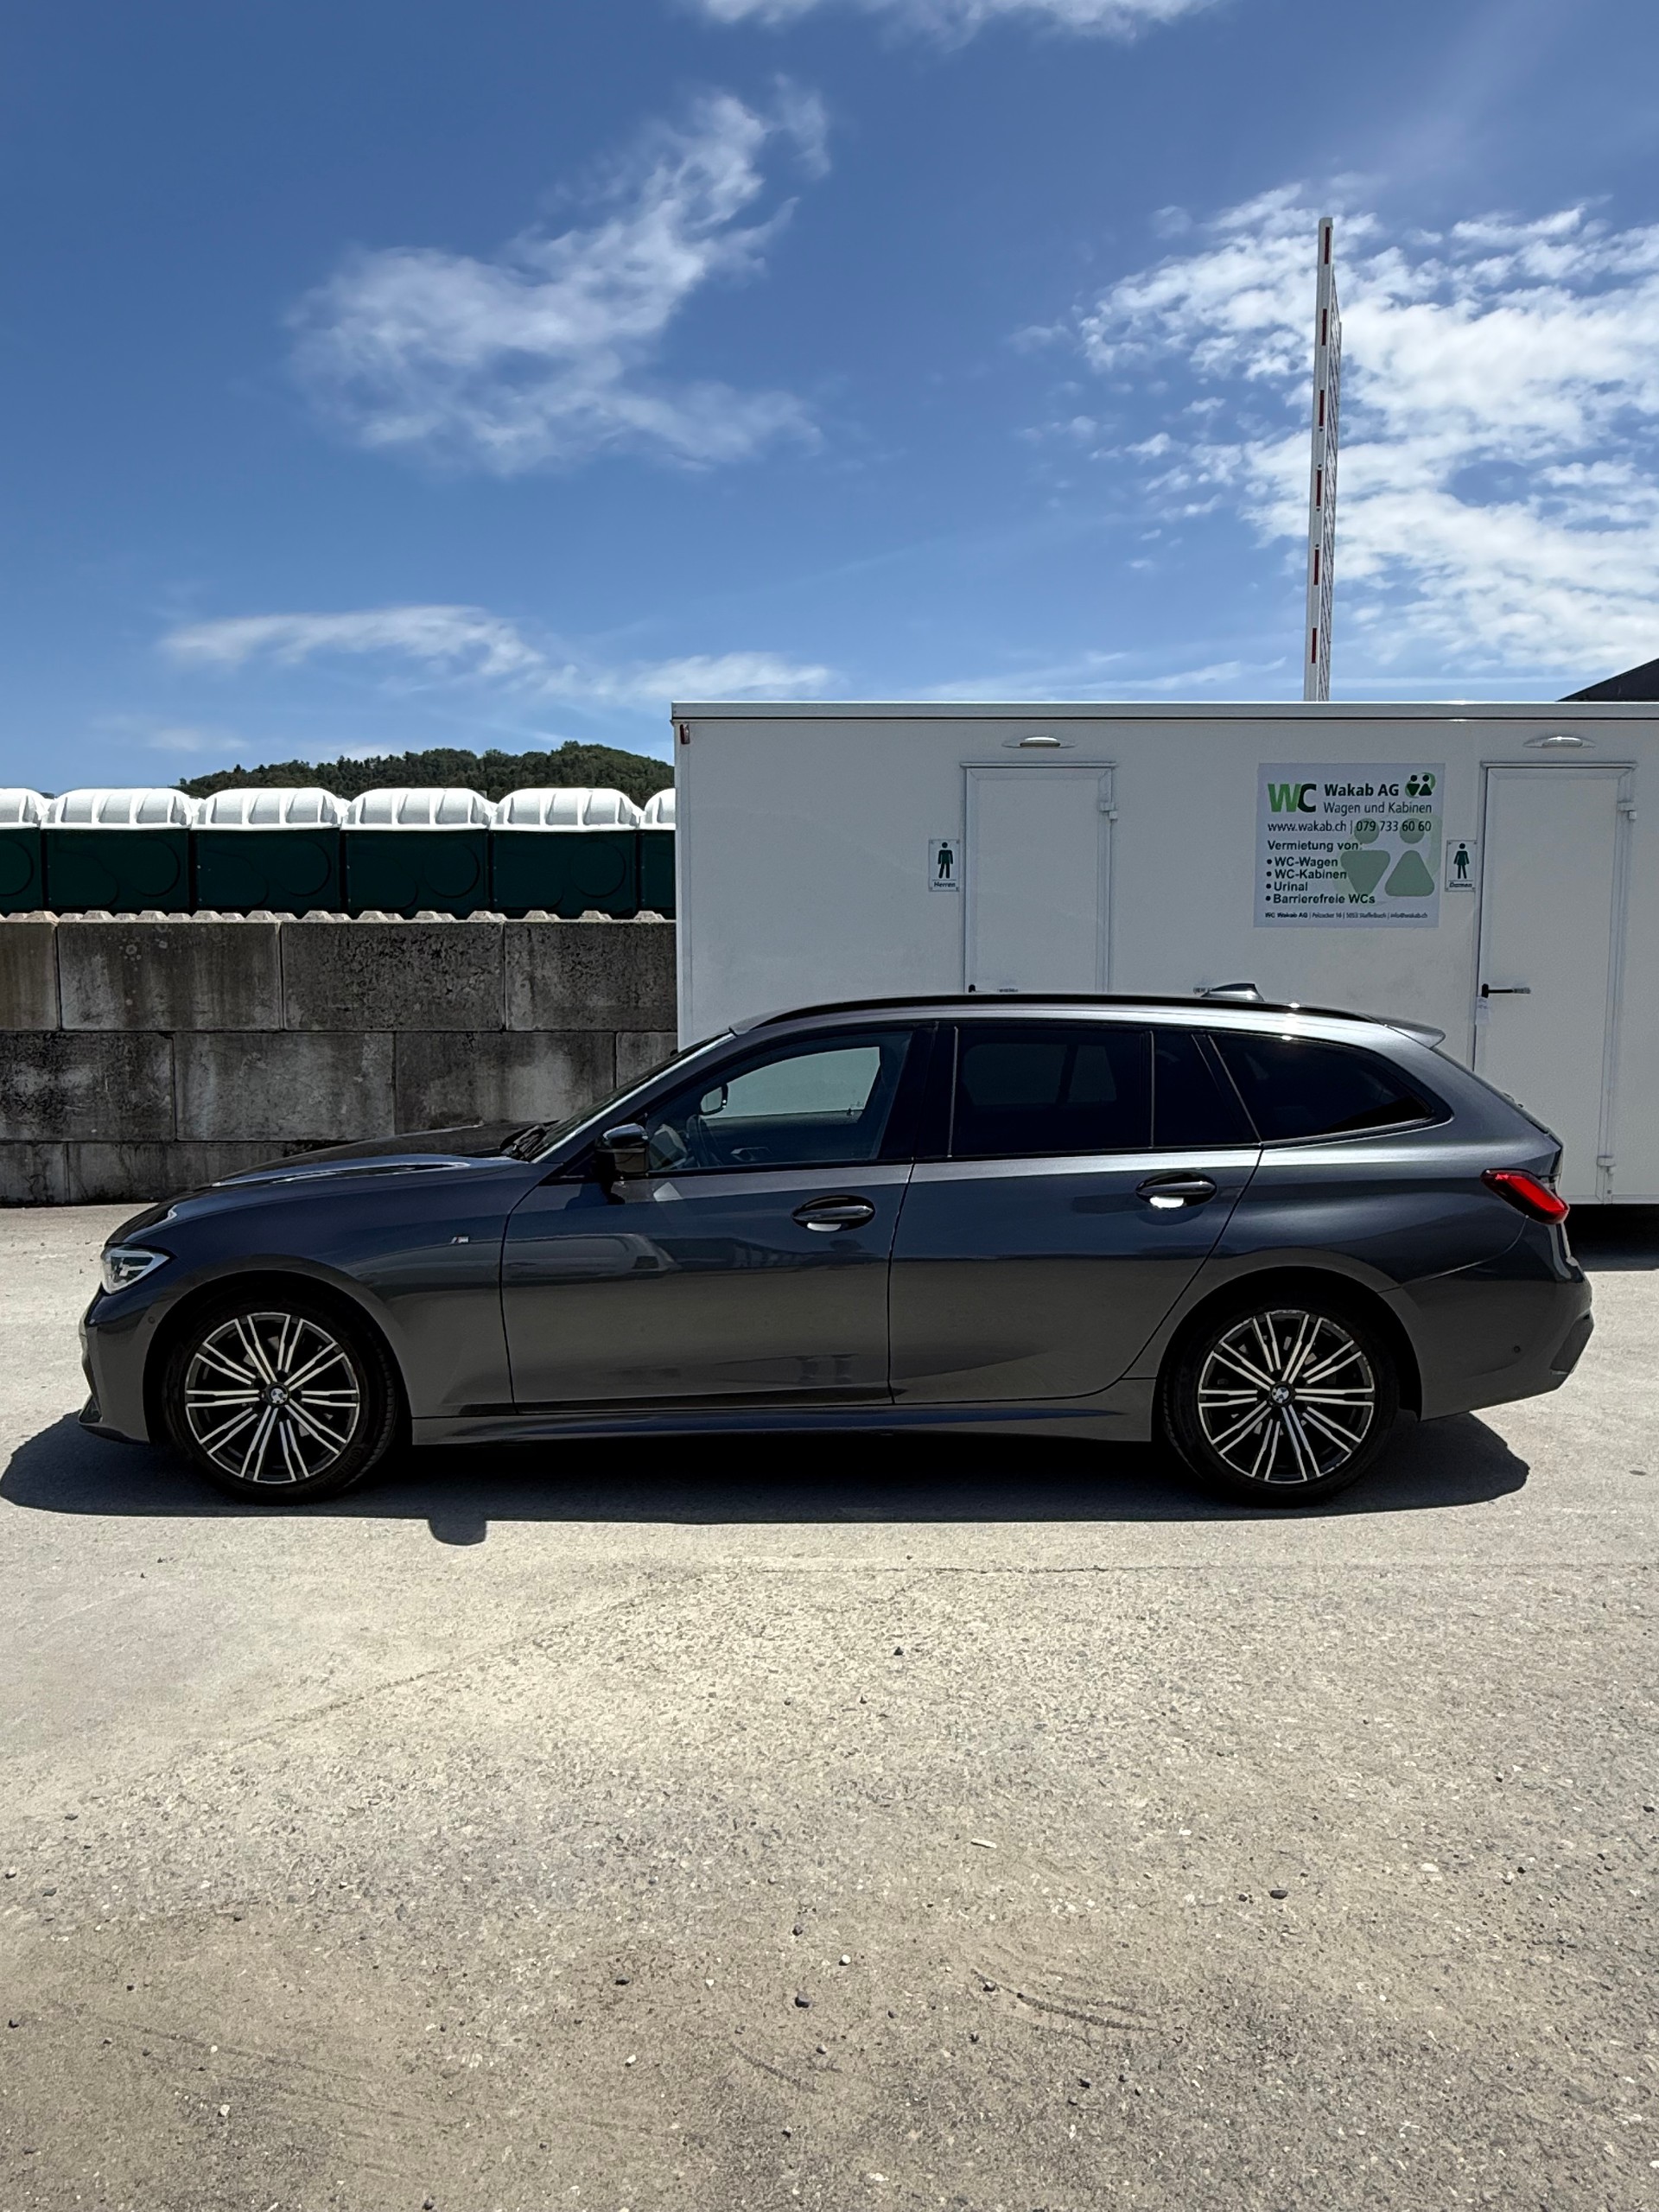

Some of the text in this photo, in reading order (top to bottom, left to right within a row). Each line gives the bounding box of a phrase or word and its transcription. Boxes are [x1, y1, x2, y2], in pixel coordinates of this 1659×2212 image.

[1324, 783, 1399, 797] Wakab AG
[1268, 783, 1317, 813] WC
[1323, 801, 1433, 817] Wagen und Kabinen
[1268, 820, 1432, 832] www.wakab.ch 079 733 60 60
[1268, 840, 1334, 853] Vermietung
[1274, 856, 1338, 869] WC-Wagen
[1274, 868, 1348, 880] WC-Kabinen
[1274, 881, 1308, 892] Urinal
[1273, 893, 1376, 904] Barrierefreie WCs
